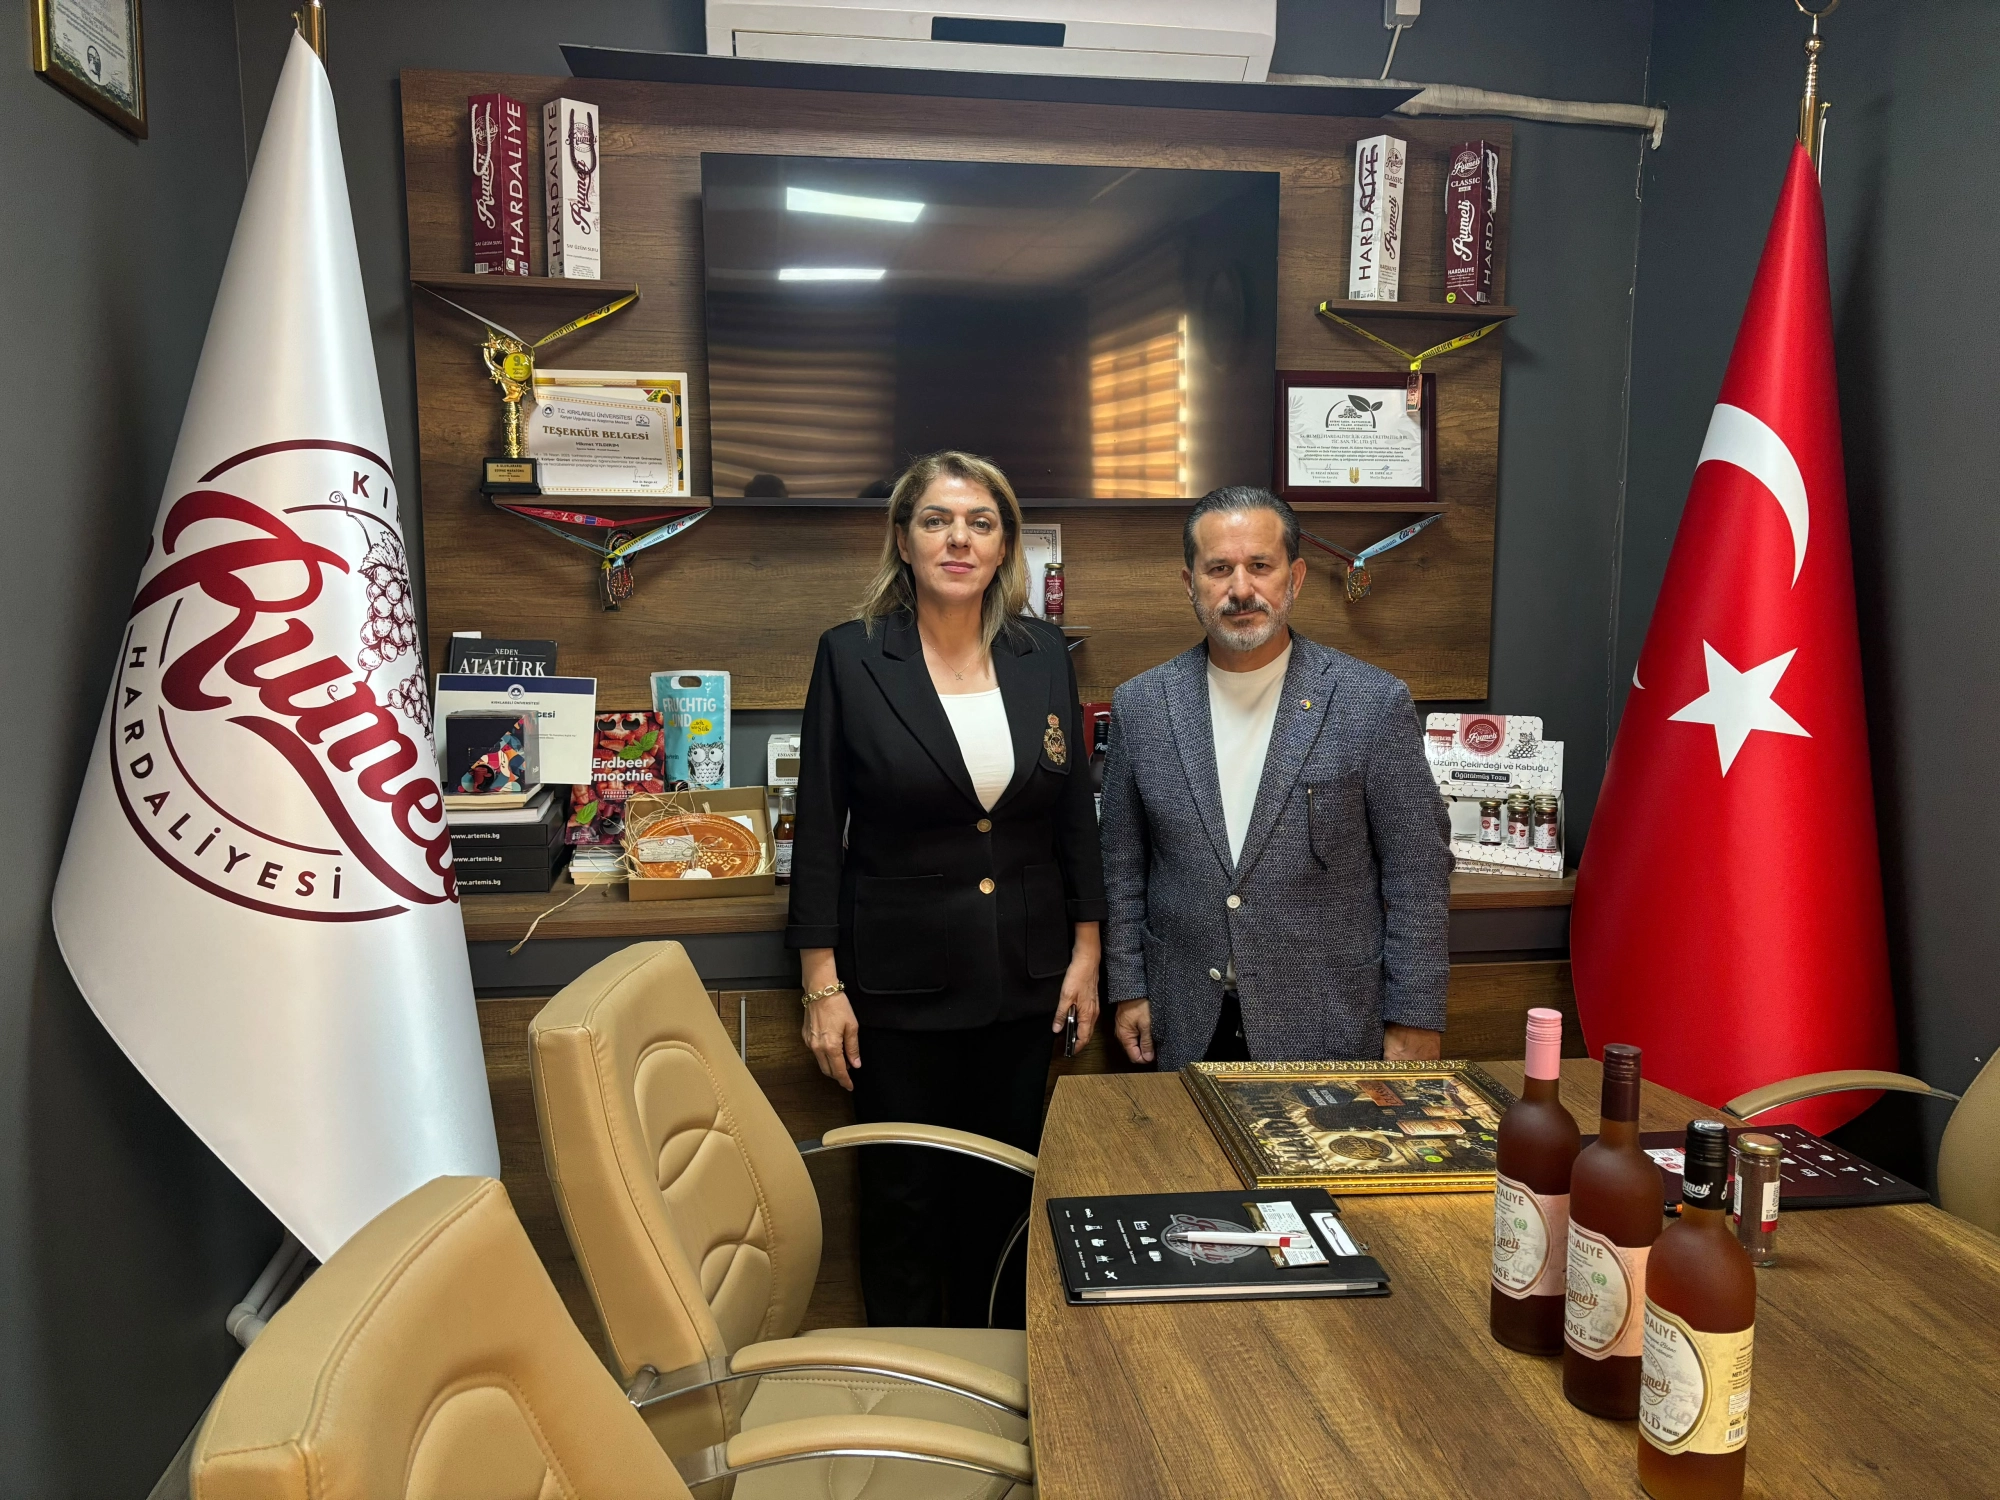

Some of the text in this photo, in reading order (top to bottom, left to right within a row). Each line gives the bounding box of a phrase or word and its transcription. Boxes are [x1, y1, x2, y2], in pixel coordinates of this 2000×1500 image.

[504, 102, 524, 256] HARDALİYE
[547, 104, 561, 257] HARDALİYE
[1384, 174, 1403, 185] CLASSIC
[1451, 177, 1480, 188] CLASSIC
[1384, 195, 1400, 260] Rumeli
[1452, 199, 1475, 262] Rumeli
[1484, 160, 1497, 286] HARDALİ
[542, 425, 650, 441] TEŞEKKÜR BELGESİ
[494, 648, 519, 656] NEDEN
[458, 657, 547, 677] ATATÜRK
[537, 710, 556, 719] GESİ
[672, 713, 692, 728] UND
[592, 756, 649, 769] Erdbeer
[1460, 761, 1502, 770] Çekirdeği
[1515, 763, 1549, 773] Kabuğu
[123, 645, 342, 900] HARDALİYESİ
[1454, 771, 1507, 781] Öğütülmüş Tozu
[453, 855, 502, 863] www.artemis.bg
[456, 878, 501, 886] ww.artemis.bg
[1496, 1185, 1525, 1206] DALİYE
[1683, 1181, 1714, 1199] umeli
[1495, 1234, 1520, 1253] meli
[1568, 1231, 1604, 1259] DALİYE
[1493, 1263, 1510, 1282] OSE
[1567, 1285, 1600, 1310] umeli
[1645, 1315, 1677, 1343] DALİYE
[1641, 1370, 1672, 1397] umeli
[1640, 1404, 1661, 1430] OLD
